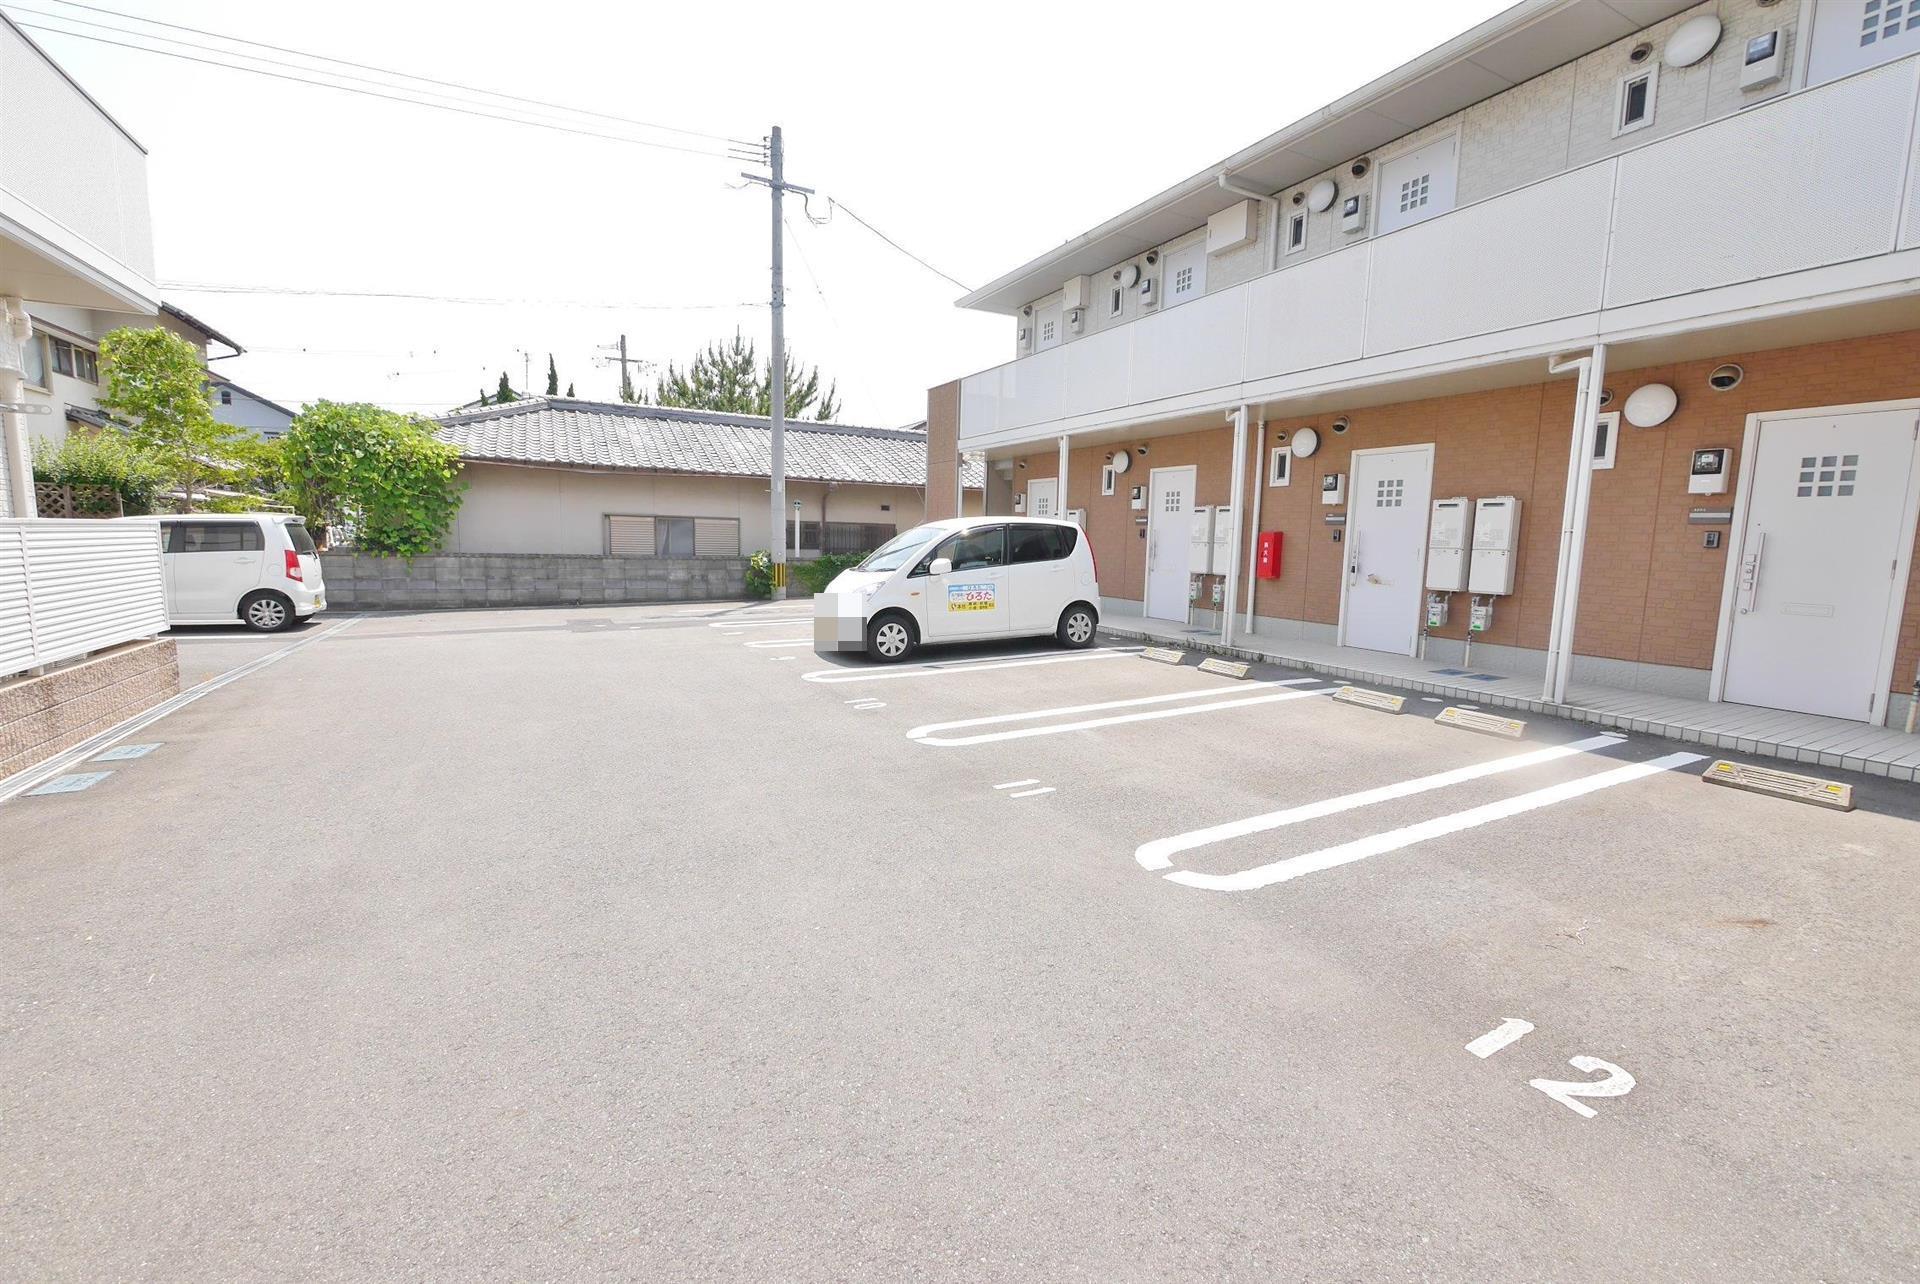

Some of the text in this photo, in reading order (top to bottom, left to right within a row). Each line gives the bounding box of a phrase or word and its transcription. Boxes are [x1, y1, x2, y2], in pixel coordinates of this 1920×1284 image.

[966, 591, 992, 601] ひろた
[992, 779, 1056, 798] 11
[1464, 1017, 1637, 1118] 12
